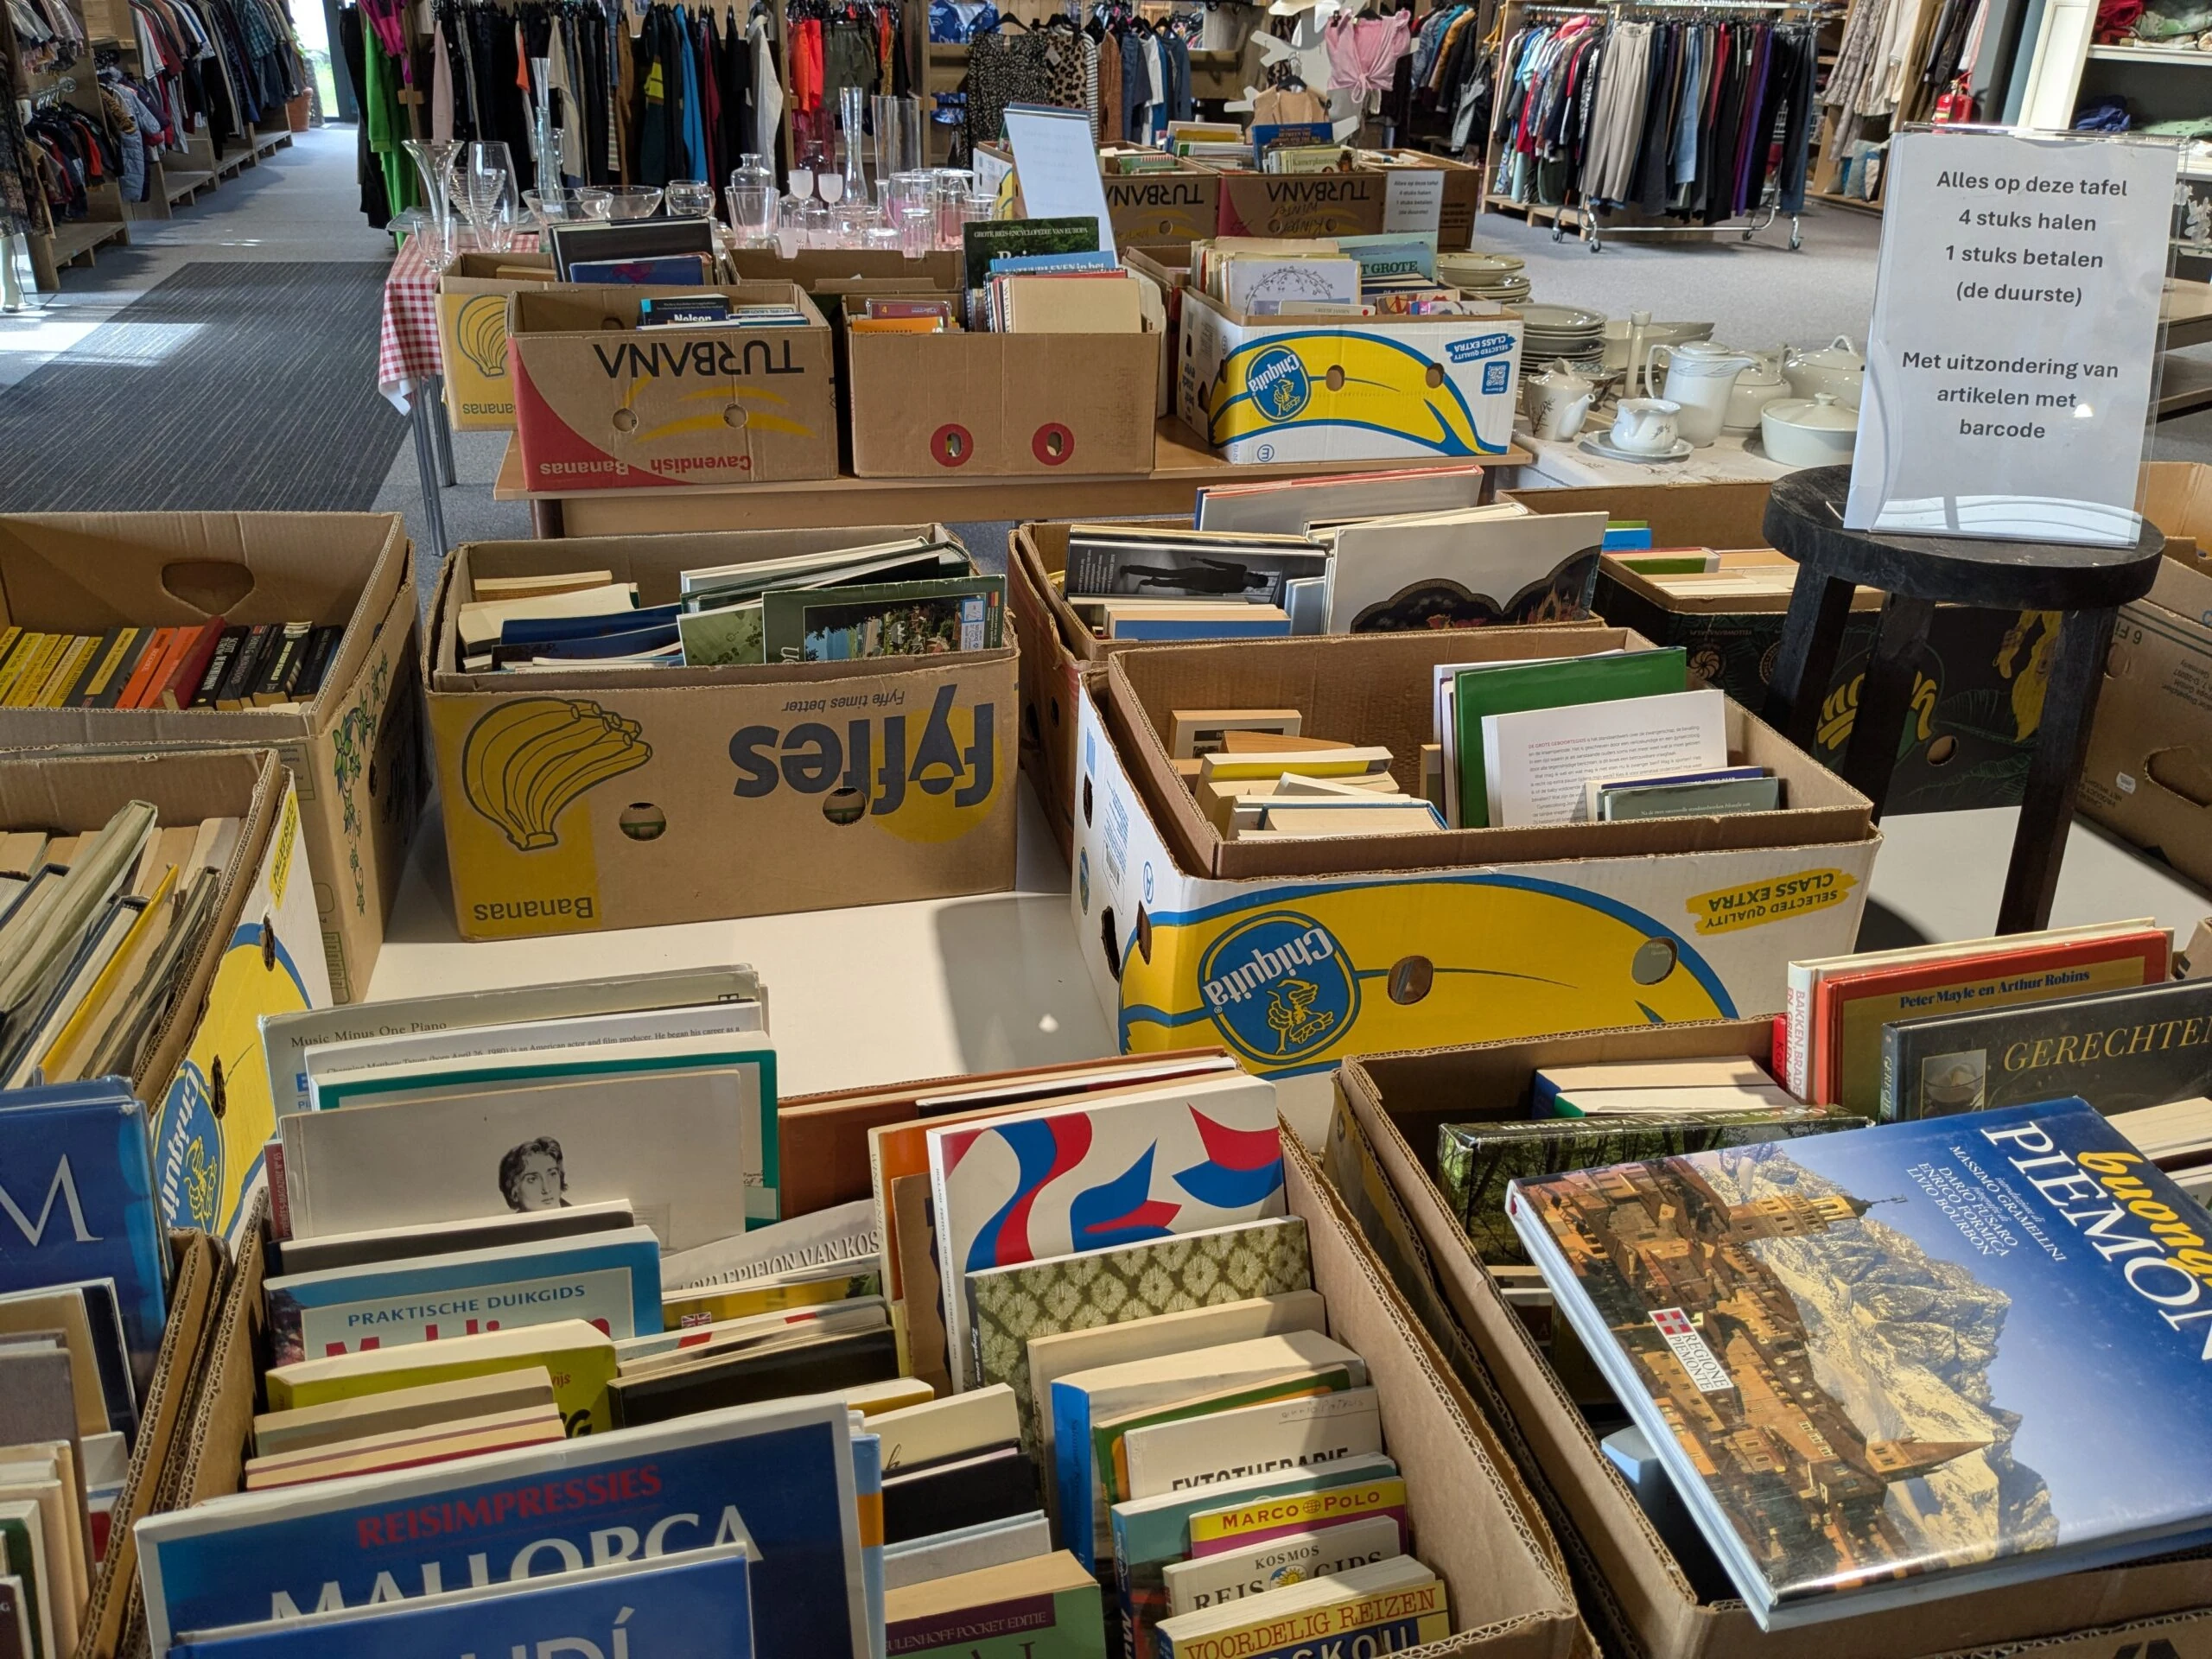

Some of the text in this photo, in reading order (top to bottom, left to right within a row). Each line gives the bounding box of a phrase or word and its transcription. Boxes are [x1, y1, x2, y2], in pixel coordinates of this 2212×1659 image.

[1267, 181, 1370, 202] TURBANA
[1936, 170, 2127, 197] Alles op deze tafel
[1065, 226, 1088, 235] EUROPA
[1958, 208, 2097, 232] 4 stuks halen
[1371, 259, 1418, 274] GROTE
[1945, 245, 2104, 269] 1 stuks betalen
[1955, 281, 2083, 307] (de duurste)
[881, 305, 888, 314] 4
[1455, 335, 1506, 352] CLASS EXTRA
[593, 340, 805, 378] TURBANA
[1902, 352, 2119, 380] Met uitzondering van
[1247, 353, 1300, 393] Chiquita
[1936, 386, 2077, 408] artikelen met
[1959, 419, 2046, 439] barcode
[540, 459, 629, 478] Bananas
[650, 454, 753, 474] Cavendish
[2133, 629, 2143, 645] 6
[2179, 659, 2209, 680] Germany
[781, 690, 906, 713] Fyffe times better
[1551, 738, 1586, 747] GEBOORTEGIDS
[1708, 873, 1835, 912] CLASS EXTRA
[472, 897, 594, 922] Bananas
[1705, 889, 1838, 929] SELECTED QUALITY
[1202, 927, 1334, 1006] Chiquita
[1899, 969, 2090, 1011] Peter Mayle en Arthur Robins
[290, 1021, 447, 1048] Music Minus One Piano
[530, 1042, 566, 1052] American
[601, 1037, 618, 1046] film
[619, 1034, 653, 1045] producer.
[653, 1032, 665, 1040] He
[666, 1030, 690, 1040] began
[690, 1028, 701, 1037] his
[702, 1027, 725, 1035] career
[1502, 1117, 1632, 1131] Van Rossem
[1705, 1111, 1749, 1122] met
[1906, 1167, 1995, 1255] LIVIO BOURBON
[1917, 1162, 2010, 1257] ENRICO FORMICA
[1937, 1166, 2018, 1247] DARIO FUSARO
[1949, 1145, 2068, 1262] MASSIMO GRAMELLINI
[799, 1230, 880, 1268] VAN KOS
[348, 1284, 586, 1327] PRAKTISCHE DUIKGIDS
[1669, 1336, 1714, 1390] PIEMONTE
[1682, 1334, 1729, 1388] REGIONE
[357, 1464, 663, 1549] REISIMPRESSIES
[1222, 1491, 1381, 1530] MARCO POLO
[1255, 1545, 1320, 1570] KOSMOS
[1193, 1580, 1264, 1611] REIS
[956, 1611, 1046, 1638] POCKET EDITIE
[1184, 1587, 1437, 1659] VOORDELIG REIZEN
